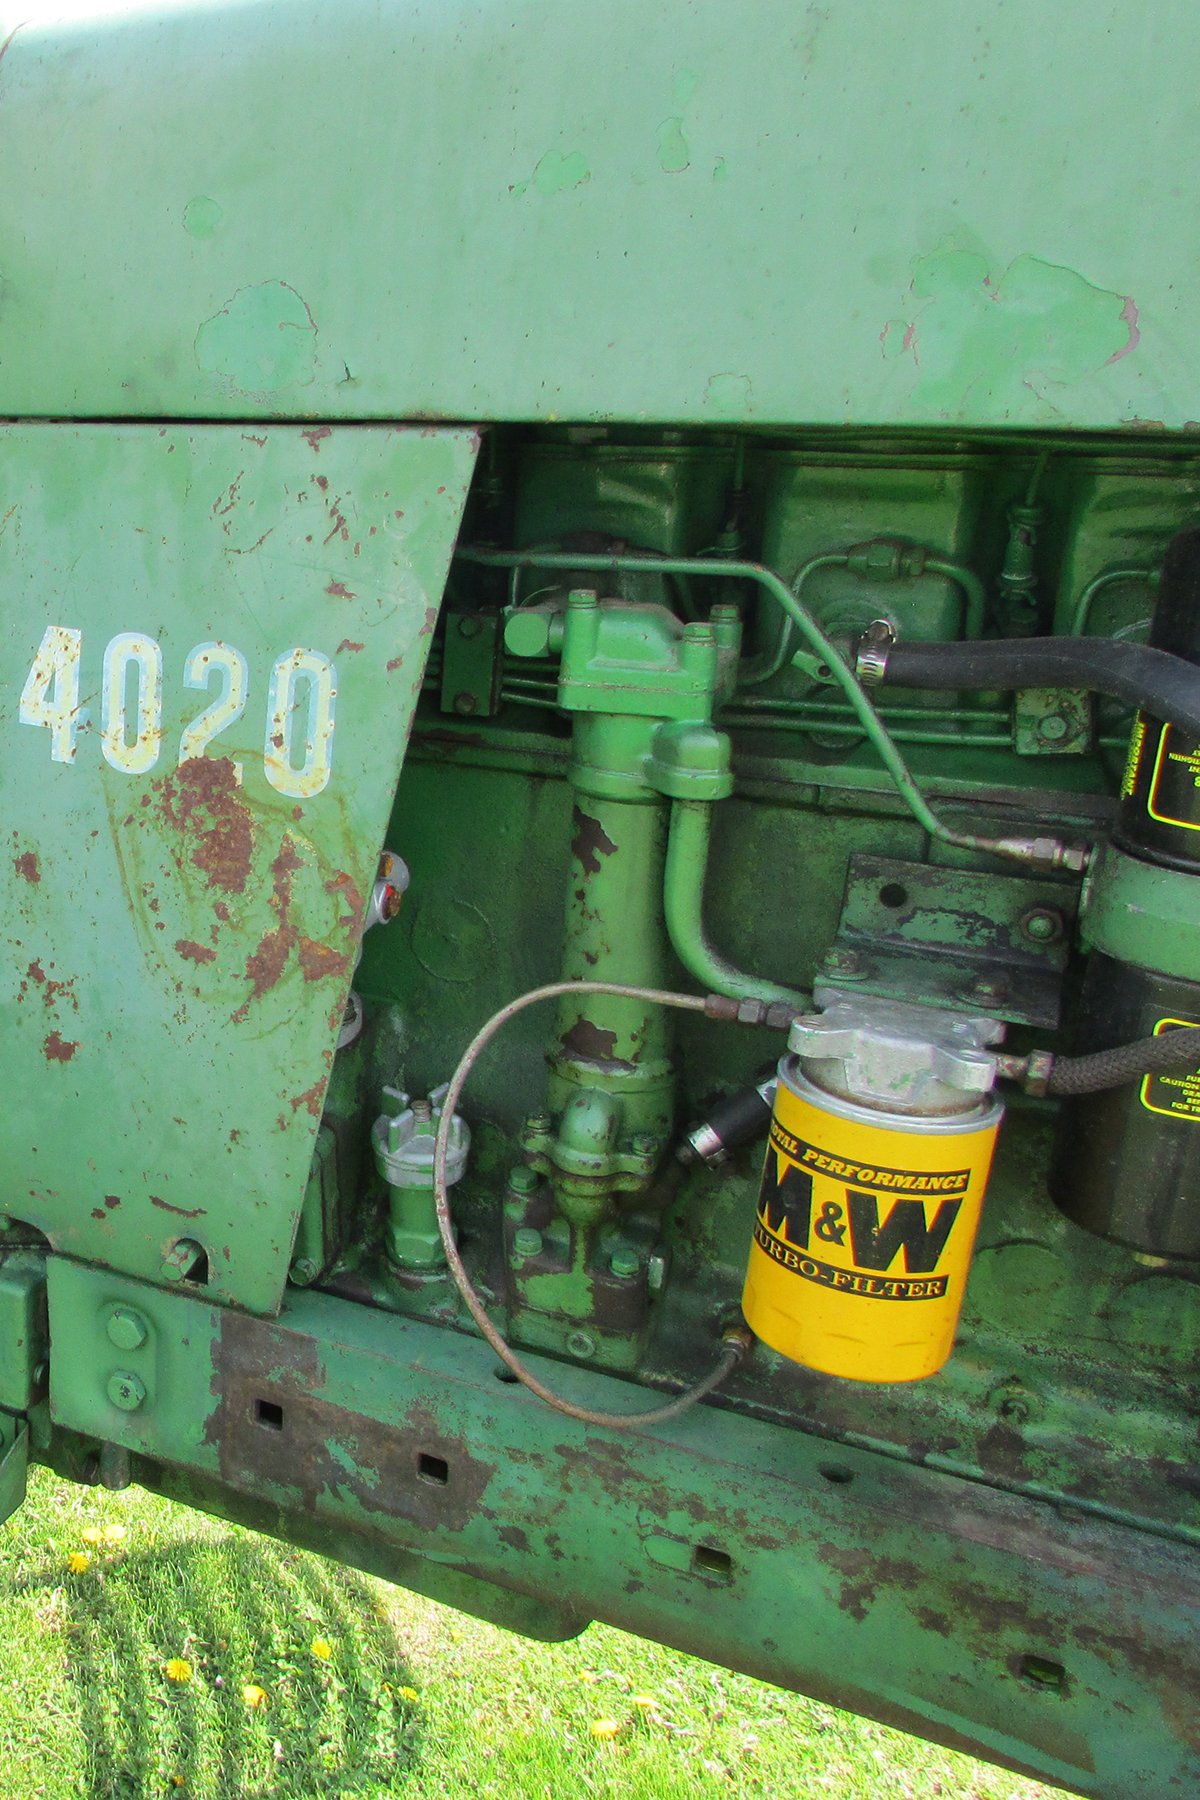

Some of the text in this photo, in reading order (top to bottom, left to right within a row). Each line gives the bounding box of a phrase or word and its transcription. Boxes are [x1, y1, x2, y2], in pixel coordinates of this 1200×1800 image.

[19, 625, 338, 798] 4020
[770, 1119, 967, 1190] OTAL PERFORMANCE
[755, 1226, 942, 1297] TURBO-FILTER
